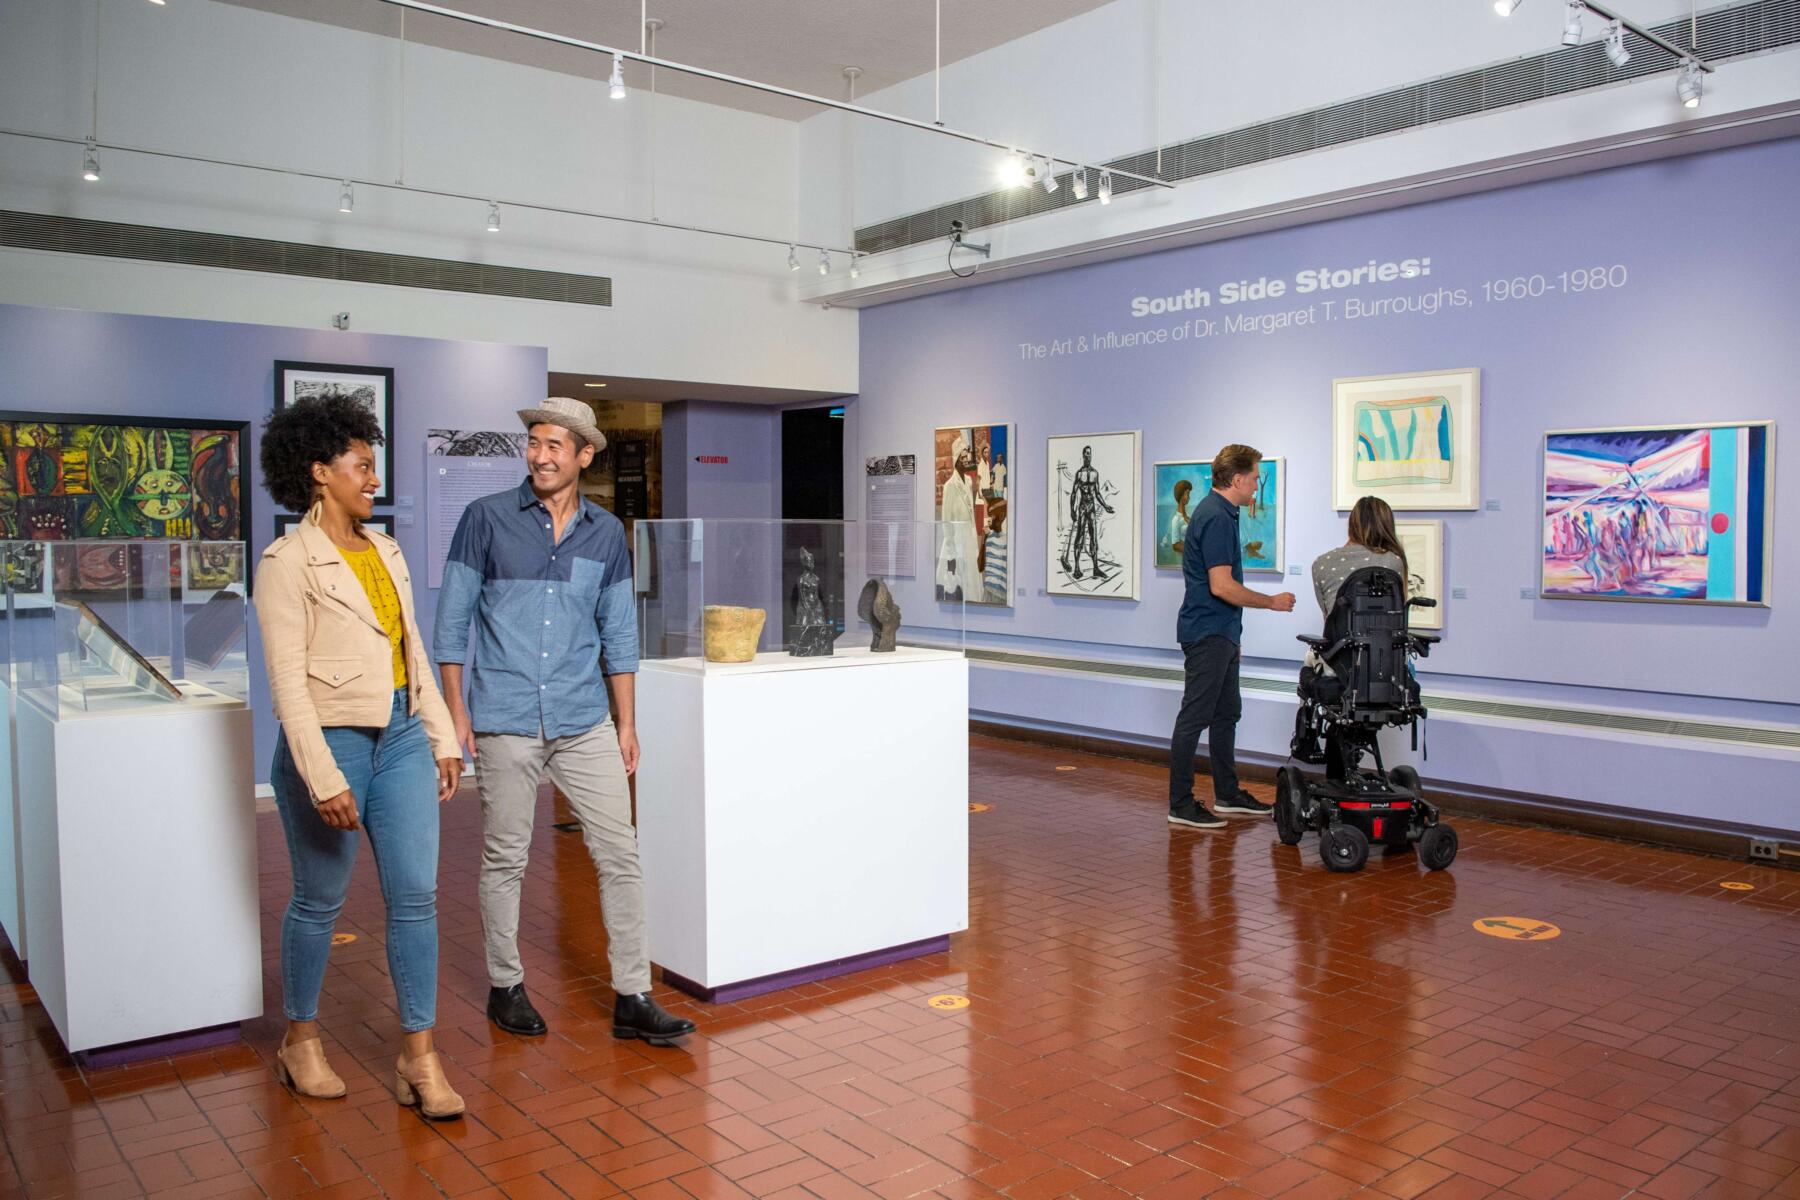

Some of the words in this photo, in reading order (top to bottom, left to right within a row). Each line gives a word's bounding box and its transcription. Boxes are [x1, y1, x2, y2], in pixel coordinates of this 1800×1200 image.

[1019, 342, 1047, 360] The
[1050, 338, 1073, 356] Art
[1077, 336, 1089, 353] &
[1093, 328, 1168, 351] Influence
[1172, 324, 1191, 341] of
[1195, 319, 1219, 338] Dr.
[1225, 304, 1316, 335] Margaret
[1321, 301, 1337, 321] T.
[1345, 287, 1473, 320] Burroughs,
[1481, 264, 1627, 302] 1960-1980
[1131, 287, 1210, 318] South
[1219, 277, 1286, 305] Side
[1295, 257, 1431, 294] Stories:
[700, 455, 729, 464] ELEVATOR
